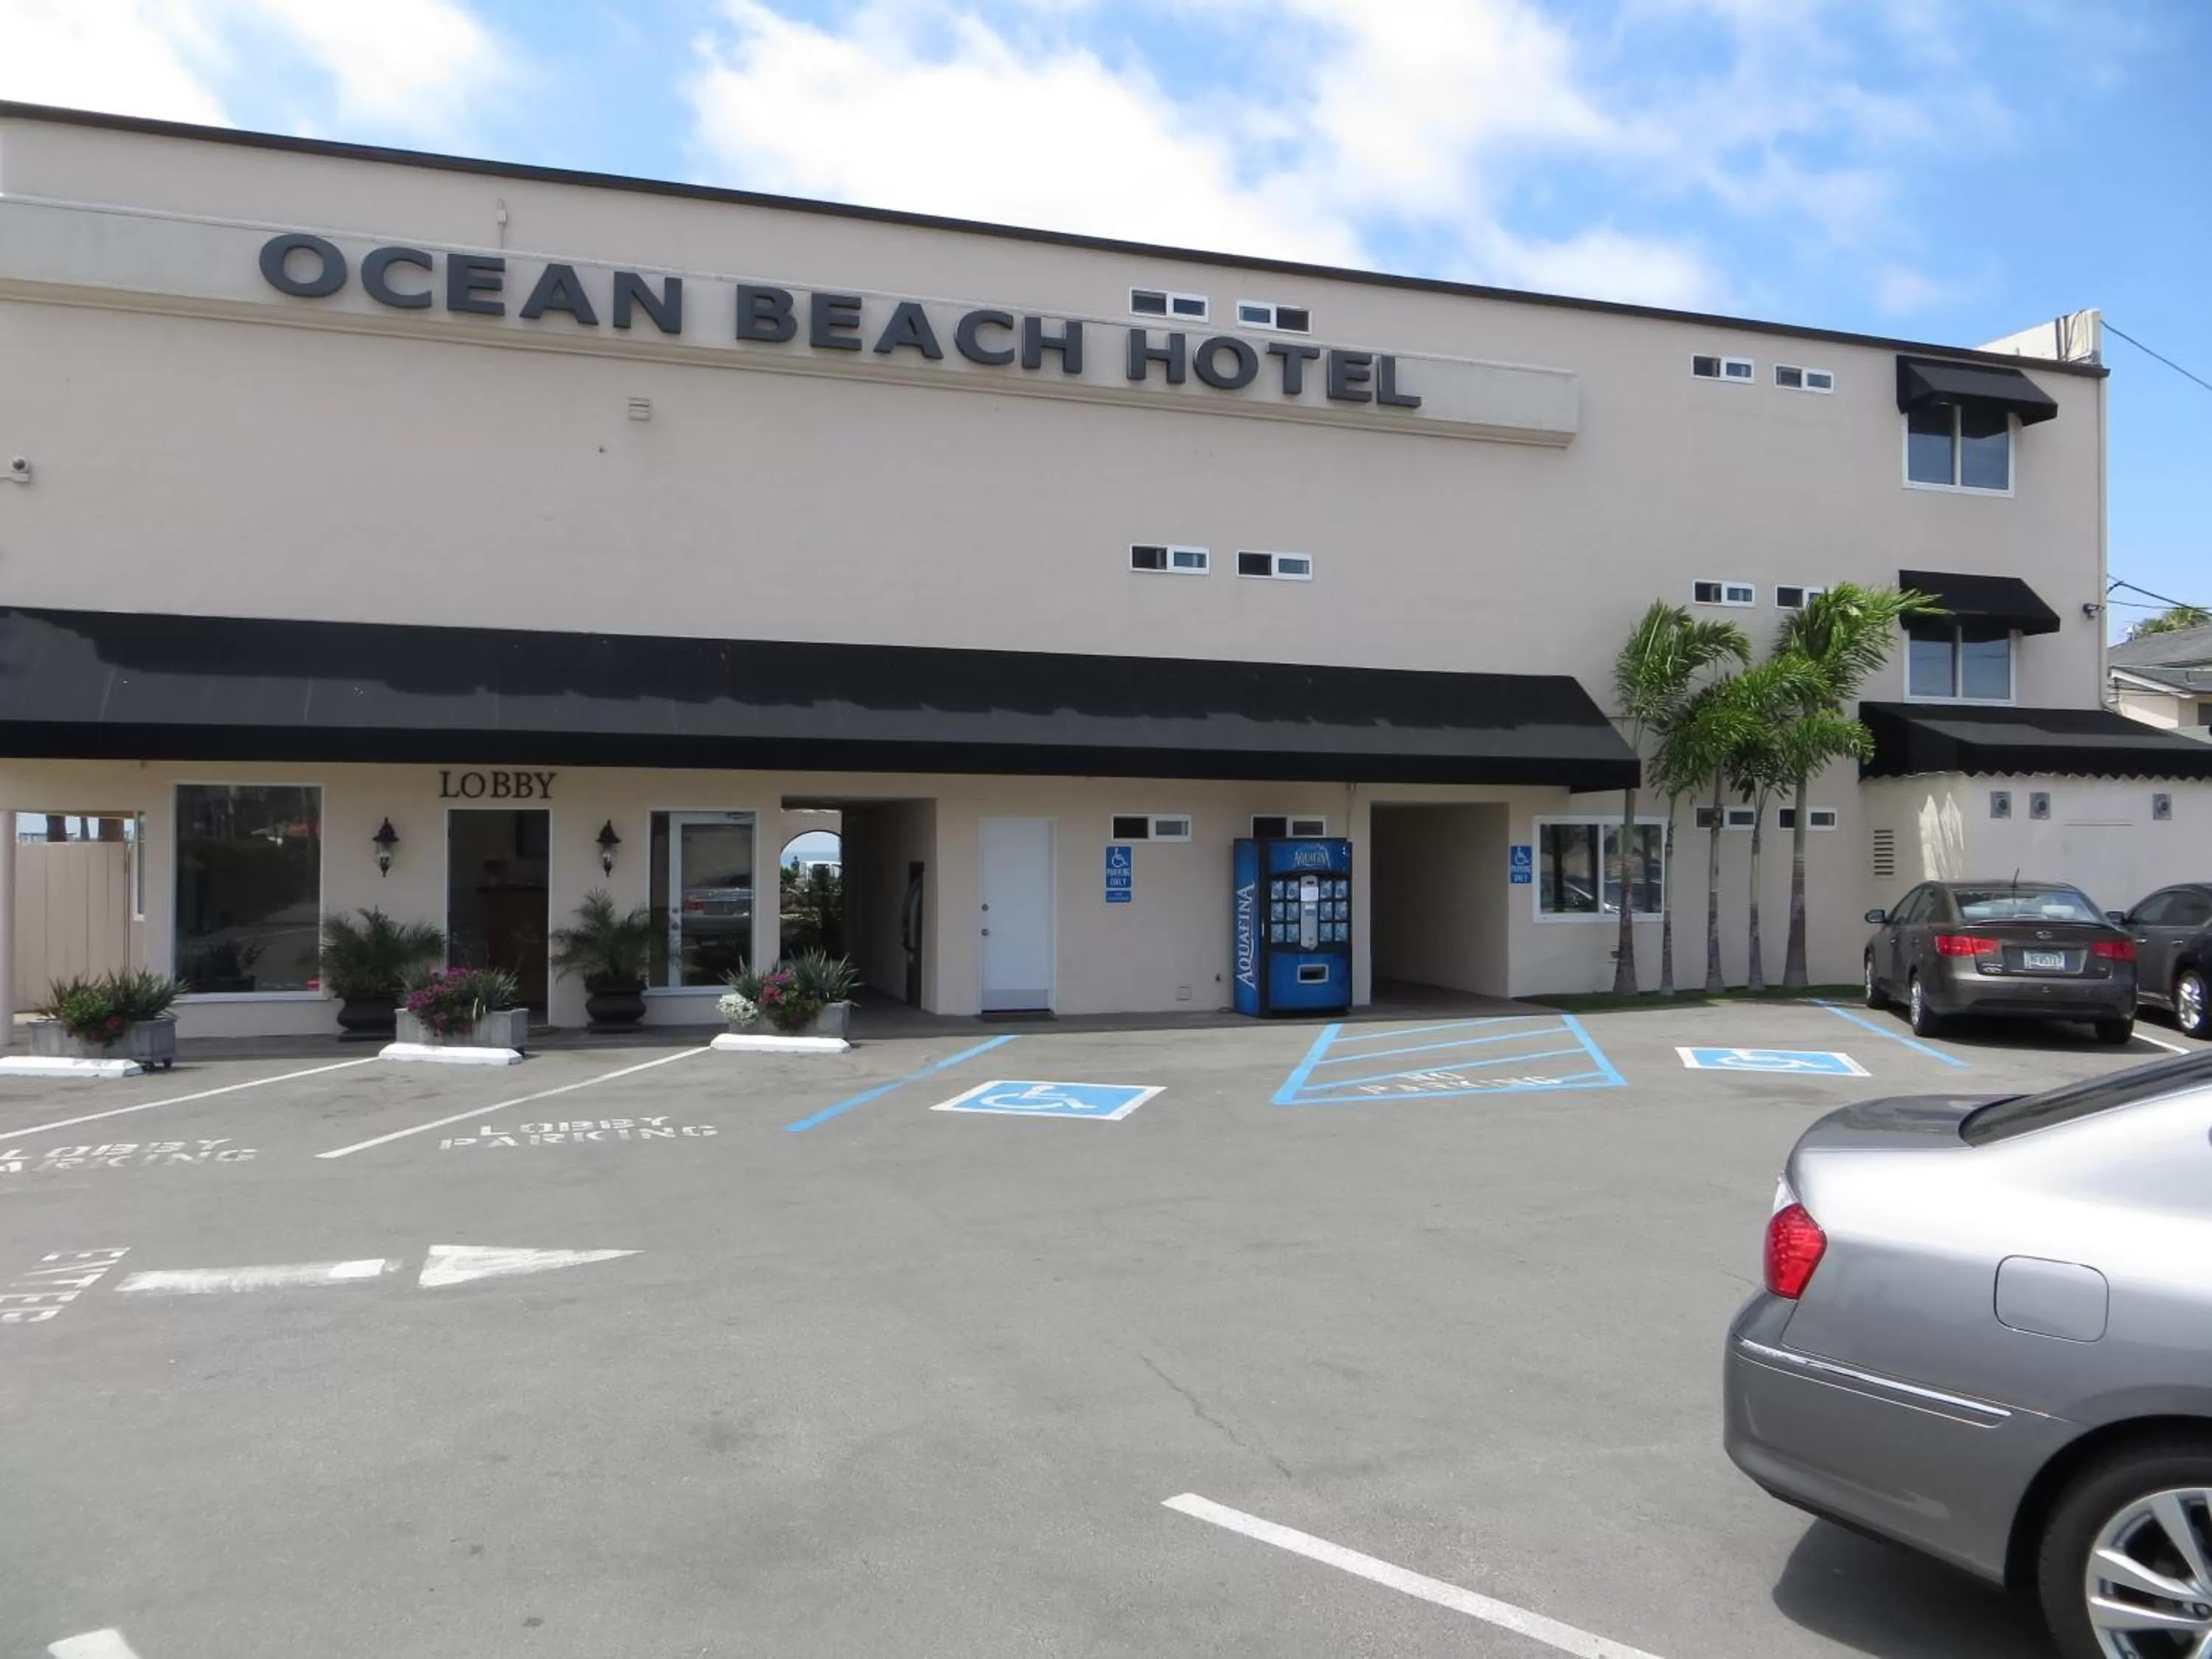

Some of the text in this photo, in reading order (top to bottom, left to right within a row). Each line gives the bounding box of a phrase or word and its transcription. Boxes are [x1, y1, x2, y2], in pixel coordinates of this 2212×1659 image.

[260, 232, 1422, 409] OCEAN BEACH HOTEL
[439, 770, 557, 799] LOBBY
[1236, 883, 1257, 991] AQUAFINA
[438, 1125, 718, 1150] PARKING
[480, 1115, 670, 1136] LOBBY
